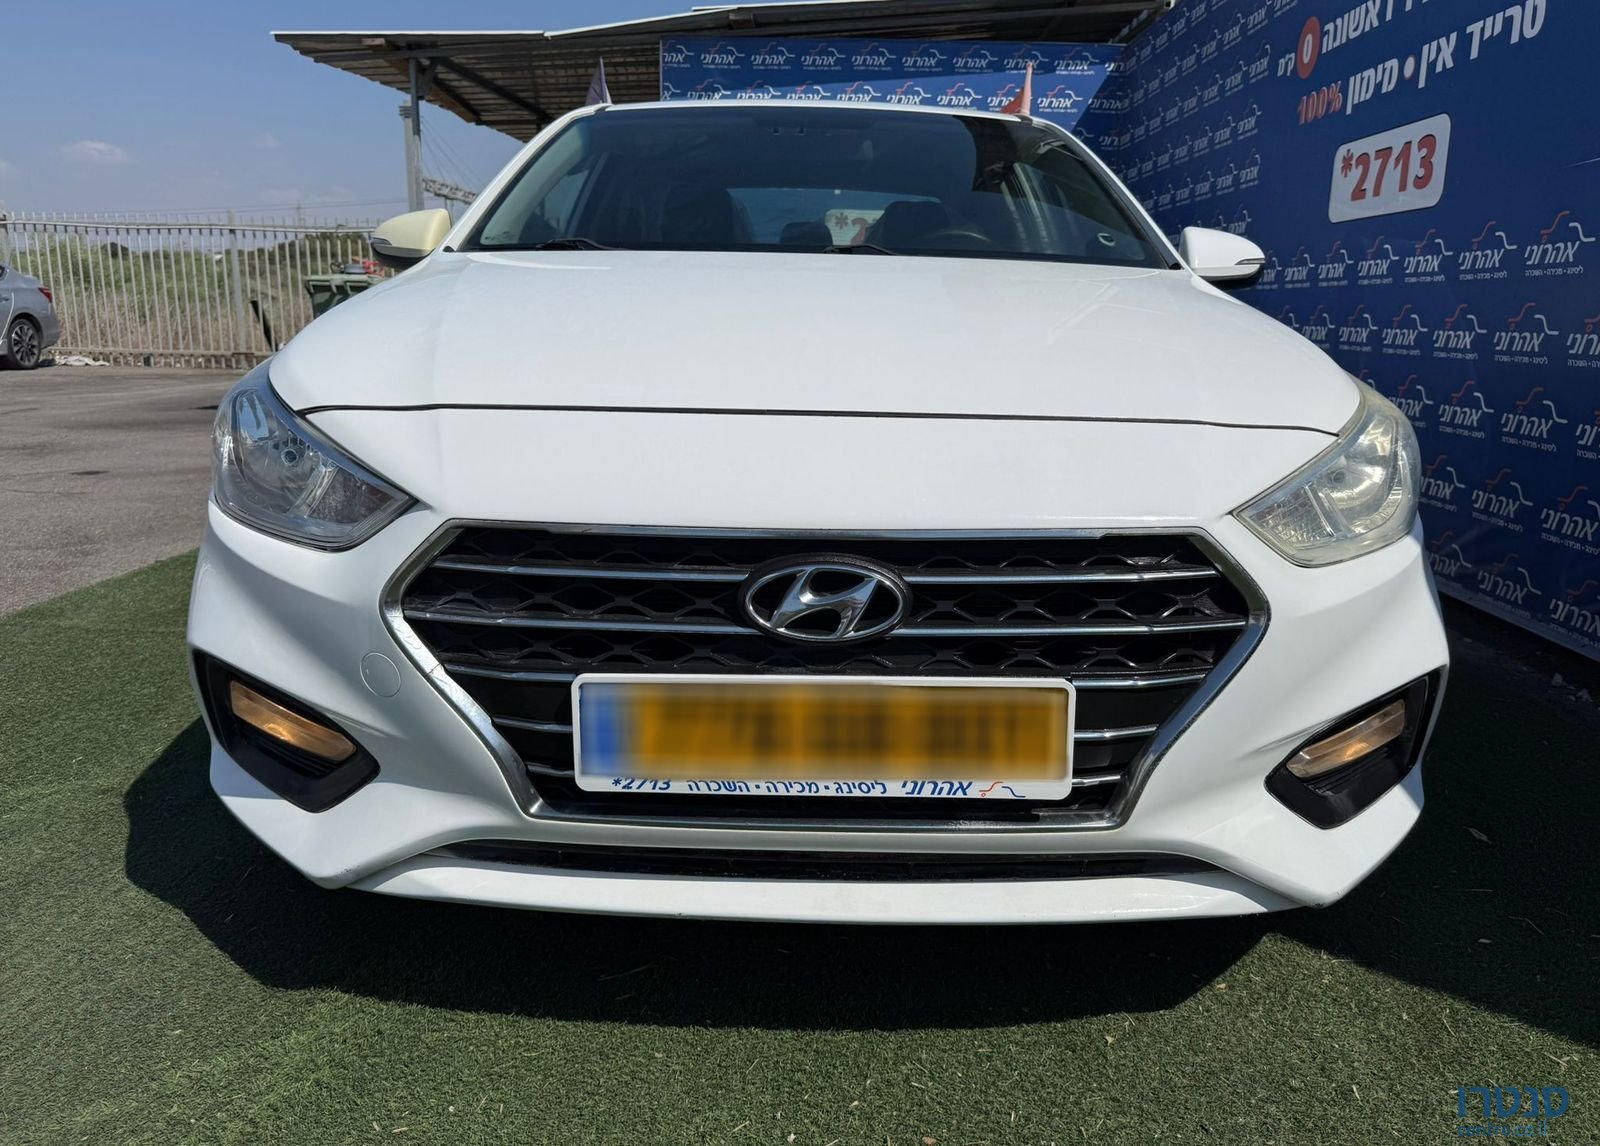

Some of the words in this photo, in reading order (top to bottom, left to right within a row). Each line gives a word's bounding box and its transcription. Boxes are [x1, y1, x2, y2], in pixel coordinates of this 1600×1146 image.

[1466, 0, 1546, 60] טרייד
[1418, 32, 1457, 88] אין
[1346, 58, 1398, 115] מימון
[1297, 80, 1342, 125] 100%
[1404, 254, 1443, 273] אהרוני
[1458, 248, 1504, 270] אהרוני
[1524, 241, 1580, 264] אהרוני
[1382, 328, 1418, 346] אהרוני
[1433, 330, 1476, 349] אהרוני
[1493, 331, 1544, 352] אהרוני
[1438, 404, 1482, 427] אהרוני
[1501, 413, 1552, 439] אהרוני
[1472, 490, 1519, 519] אהרוני
[1540, 508, 1599, 541] אהרוני
[1478, 570, 1528, 605] אהרוני
[686, 780, 751, 793] השכרה
[765, 781, 820, 794] מכירה
[834, 780, 887, 795] ליסינג
[902, 781, 973, 796] אהרוני
